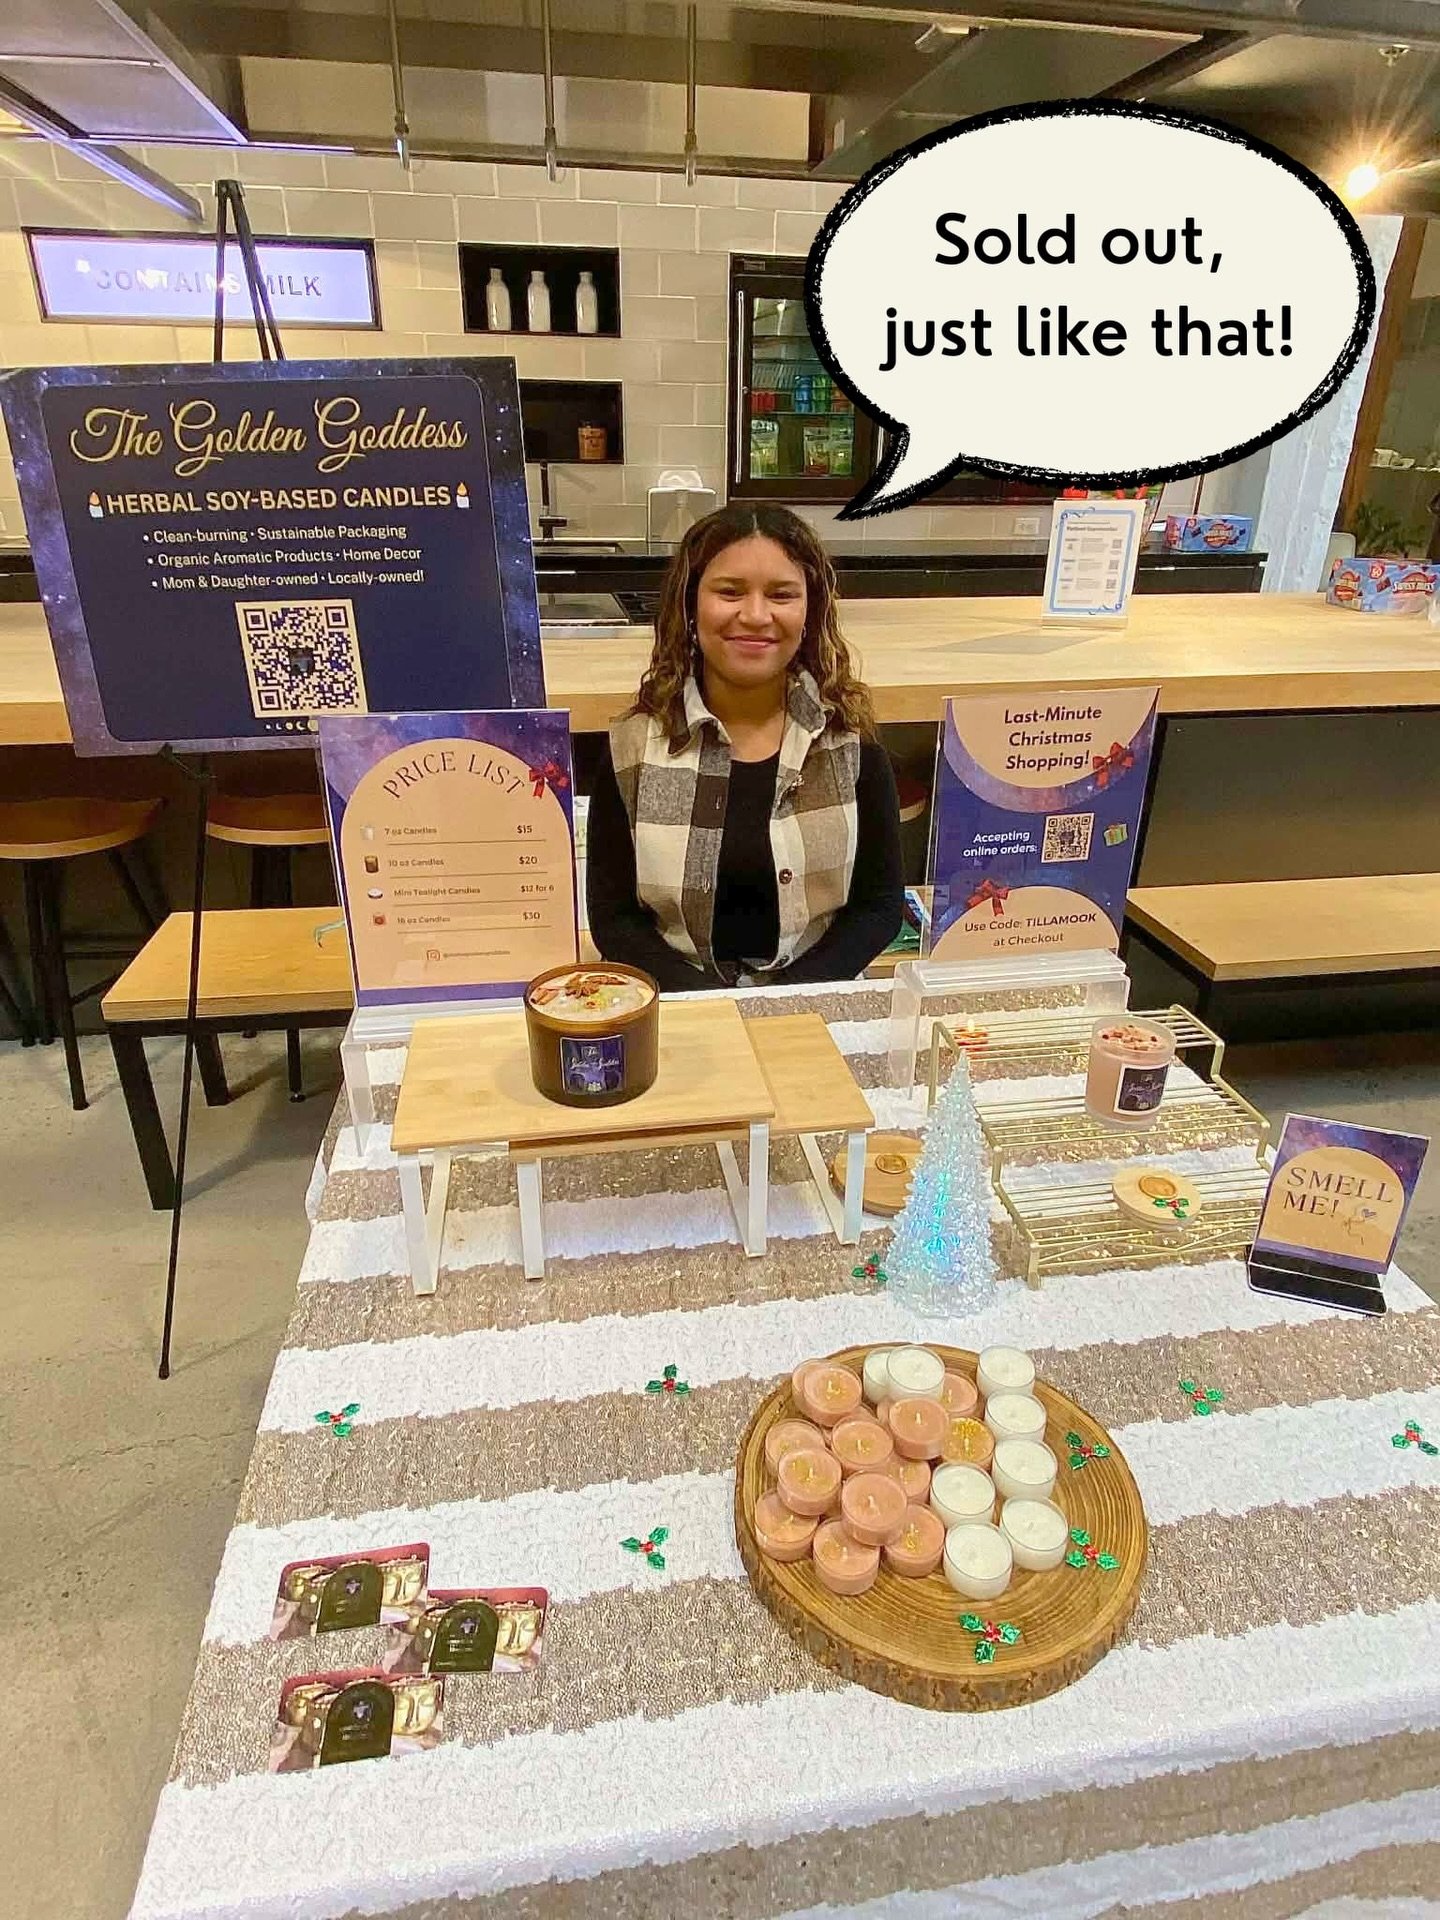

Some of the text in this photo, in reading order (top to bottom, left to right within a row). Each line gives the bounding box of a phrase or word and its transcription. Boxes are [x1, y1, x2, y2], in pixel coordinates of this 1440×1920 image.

[71, 397, 468, 476] The Golden Goddess
[106, 486, 451, 513] HERBAL SOY-BASED CANDLES
[153, 525, 407, 543] Clean-burning Sustainable Packaging
[158, 547, 422, 568] Organic Aromatic Products Home Decor
[162, 570, 424, 590] Mom & Daughter-owned Locally-owned!
[1004, 706, 1102, 724] Last-Minute
[1009, 730, 1093, 747] Christmas
[1006, 750, 1090, 771] Shopping!
[382, 751, 525, 798] PRICE LIST
[403, 826, 437, 835] Candles
[517, 824, 533, 835] $15
[973, 830, 1031, 844] Accepting
[963, 846, 998, 857] online
[411, 858, 444, 867] Candles
[519, 856, 538, 866] $20
[413, 887, 447, 896] Tealight
[448, 886, 481, 895] Candles
[535, 884, 547, 893] for
[418, 914, 451, 924] Candles
[523, 911, 541, 921] $30
[965, 913, 1097, 932] Use Code: TILLAMOOK
[993, 932, 1064, 947] at Checkout
[1287, 1166, 1393, 1203] SMELL
[1283, 1190, 1340, 1217] ME!
